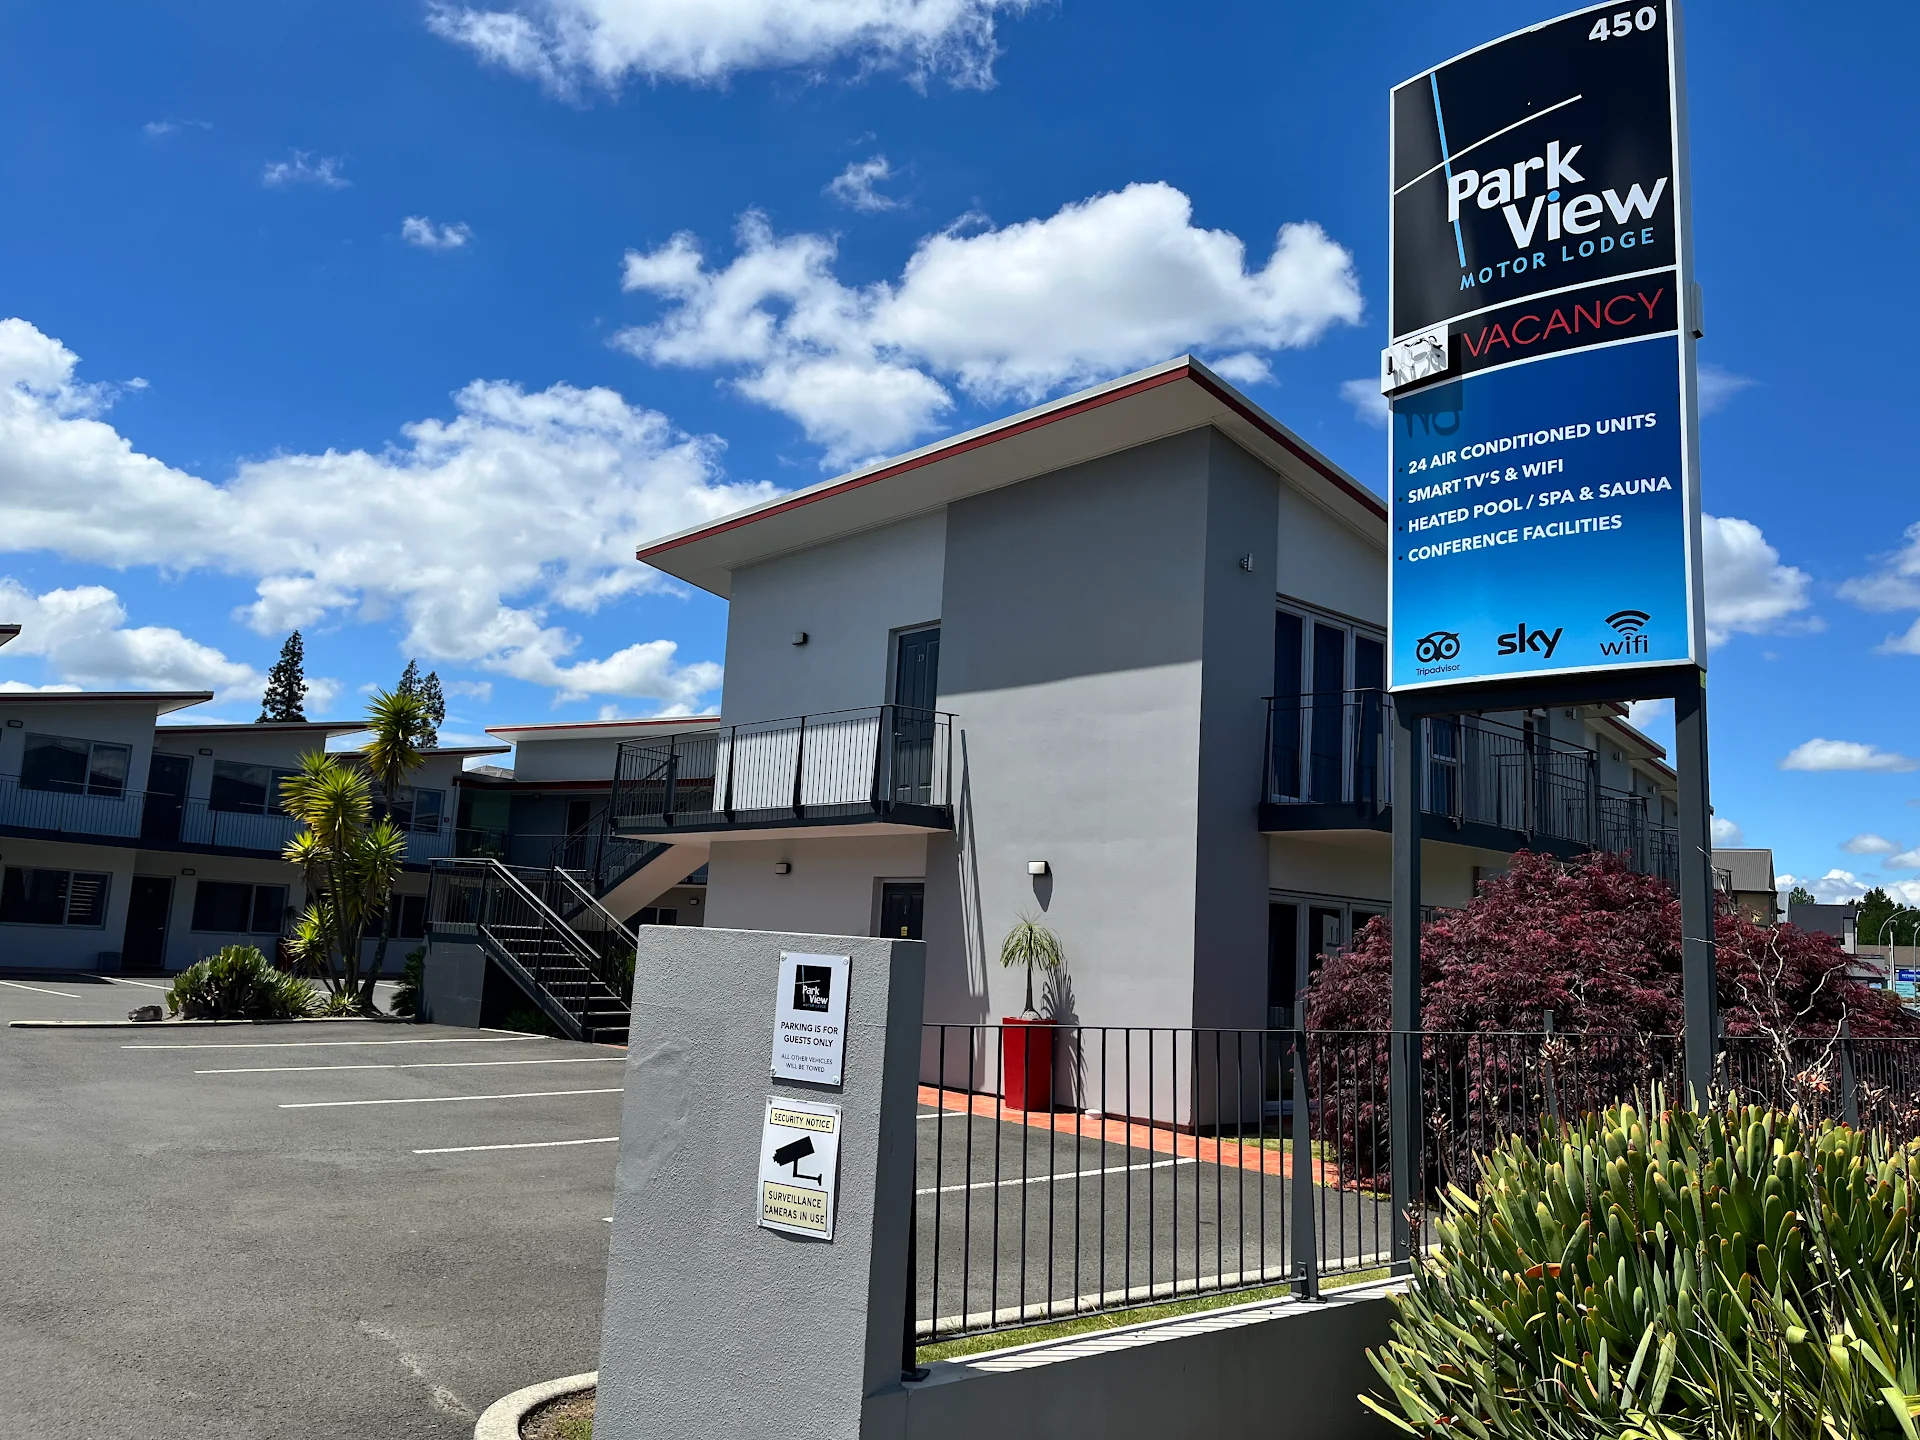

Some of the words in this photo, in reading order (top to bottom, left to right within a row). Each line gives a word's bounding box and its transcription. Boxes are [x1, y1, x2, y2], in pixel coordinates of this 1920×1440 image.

[1589, 6, 1657, 41] 450
[1448, 140, 1585, 222] Park
[1502, 177, 1668, 249] View
[1460, 251, 1547, 290] MOTOR
[1562, 227, 1655, 262] LODGE
[1463, 287, 1664, 357] VACANCY
[1408, 457, 1428, 475] 24
[1430, 450, 1457, 470] AIR
[1460, 423, 1591, 461] CONDITIONED
[1596, 412, 1657, 436] UNITS
[1408, 479, 1462, 503] SMART
[1505, 467, 1518, 482] &
[1522, 459, 1564, 478] WIFI
[1408, 508, 1469, 533] HEATED
[1473, 497, 1522, 520] POOL
[1538, 489, 1575, 508] SPA
[1579, 486, 1594, 501] &
[1599, 476, 1672, 498] SAUNA
[1408, 528, 1518, 562] CONFERENCE
[1523, 514, 1622, 541] FACILITIES
[1497, 623, 1563, 658] sky
[1600, 634, 1648, 656] wifi
[1416, 663, 1461, 676] Tripadvisor
[802, 985, 820, 996] Park
[809, 994, 828, 1004] View
[780, 1022, 812, 1032] PARKING
[823, 1026, 838, 1035] FOR
[784, 1035, 811, 1045] GUESTS
[813, 1038, 834, 1047] ONLY
[791, 1054, 808, 1062] OTHER
[809, 1056, 833, 1065] VEHICLES
[806, 1065, 825, 1073] TOWED
[774, 1113, 803, 1125] SECURITY
[806, 1117, 831, 1129] NOTICE
[768, 1191, 821, 1209] SURVEILLANCE
[765, 1205, 797, 1219] CAMERAS
[800, 1211, 807, 1221] IN
[810, 1213, 825, 1224] USE
